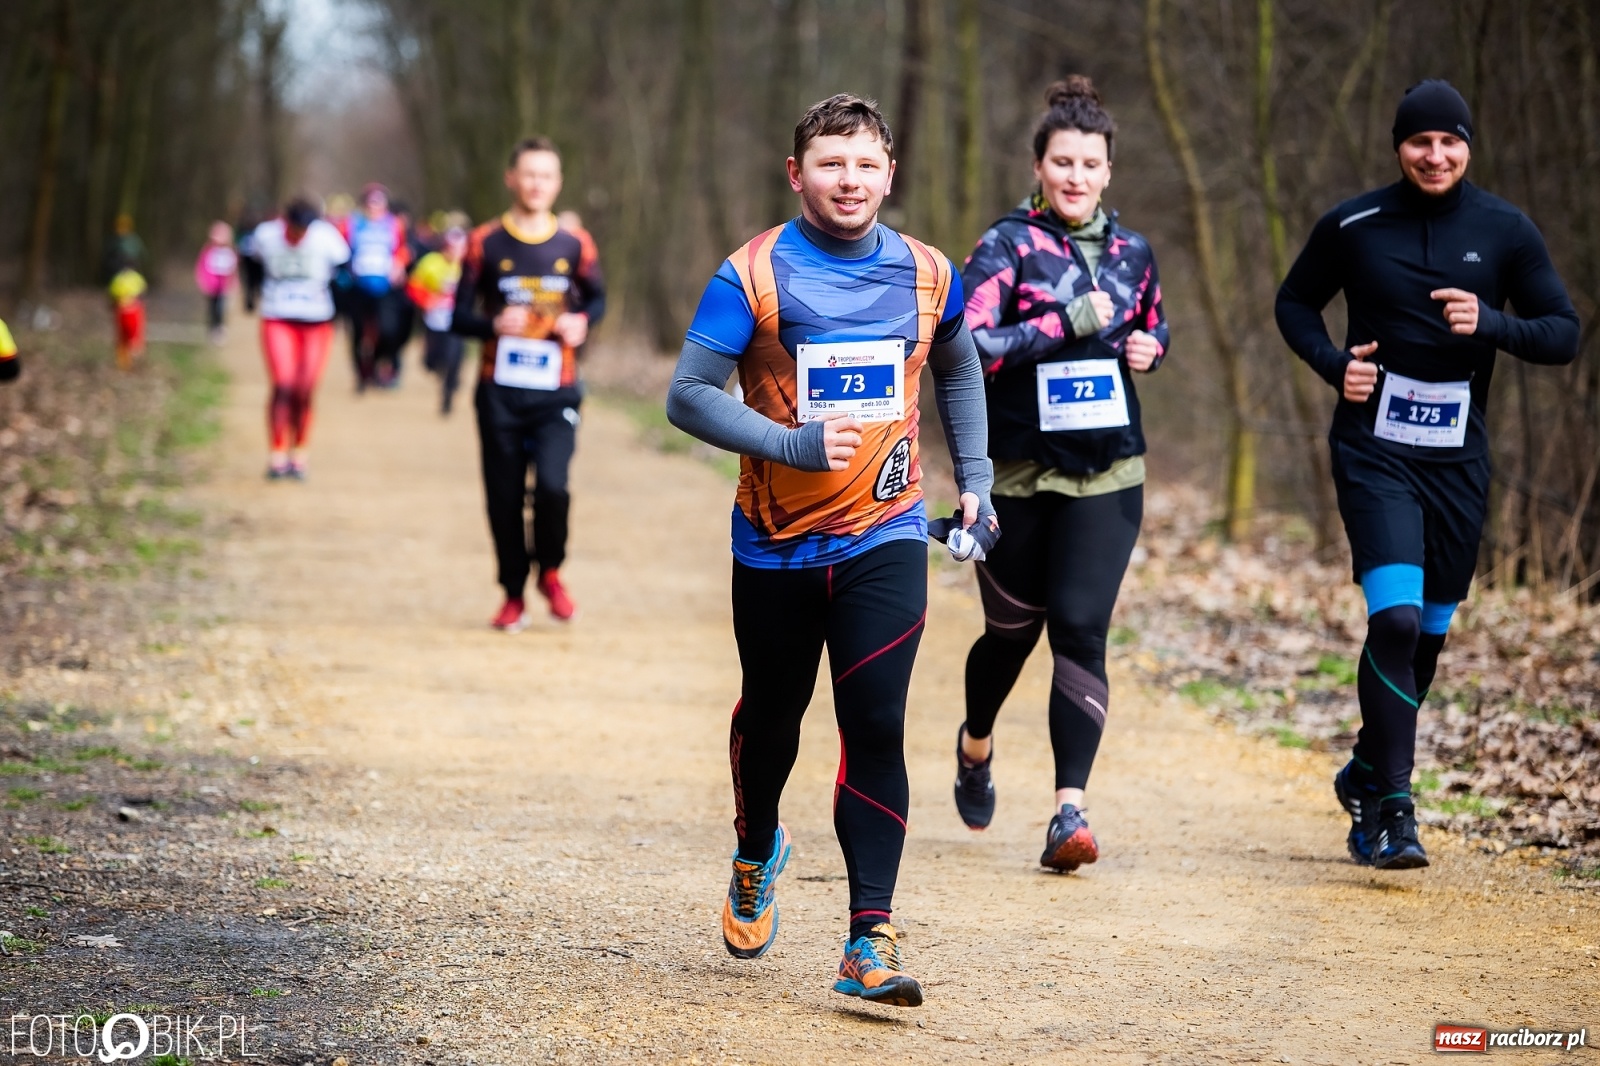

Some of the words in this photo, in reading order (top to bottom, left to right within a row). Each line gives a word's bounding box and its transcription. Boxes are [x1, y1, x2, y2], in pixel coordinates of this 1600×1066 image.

[840, 374, 866, 393] 73
[1072, 380, 1096, 399] 72
[1408, 405, 1441, 424] 175
